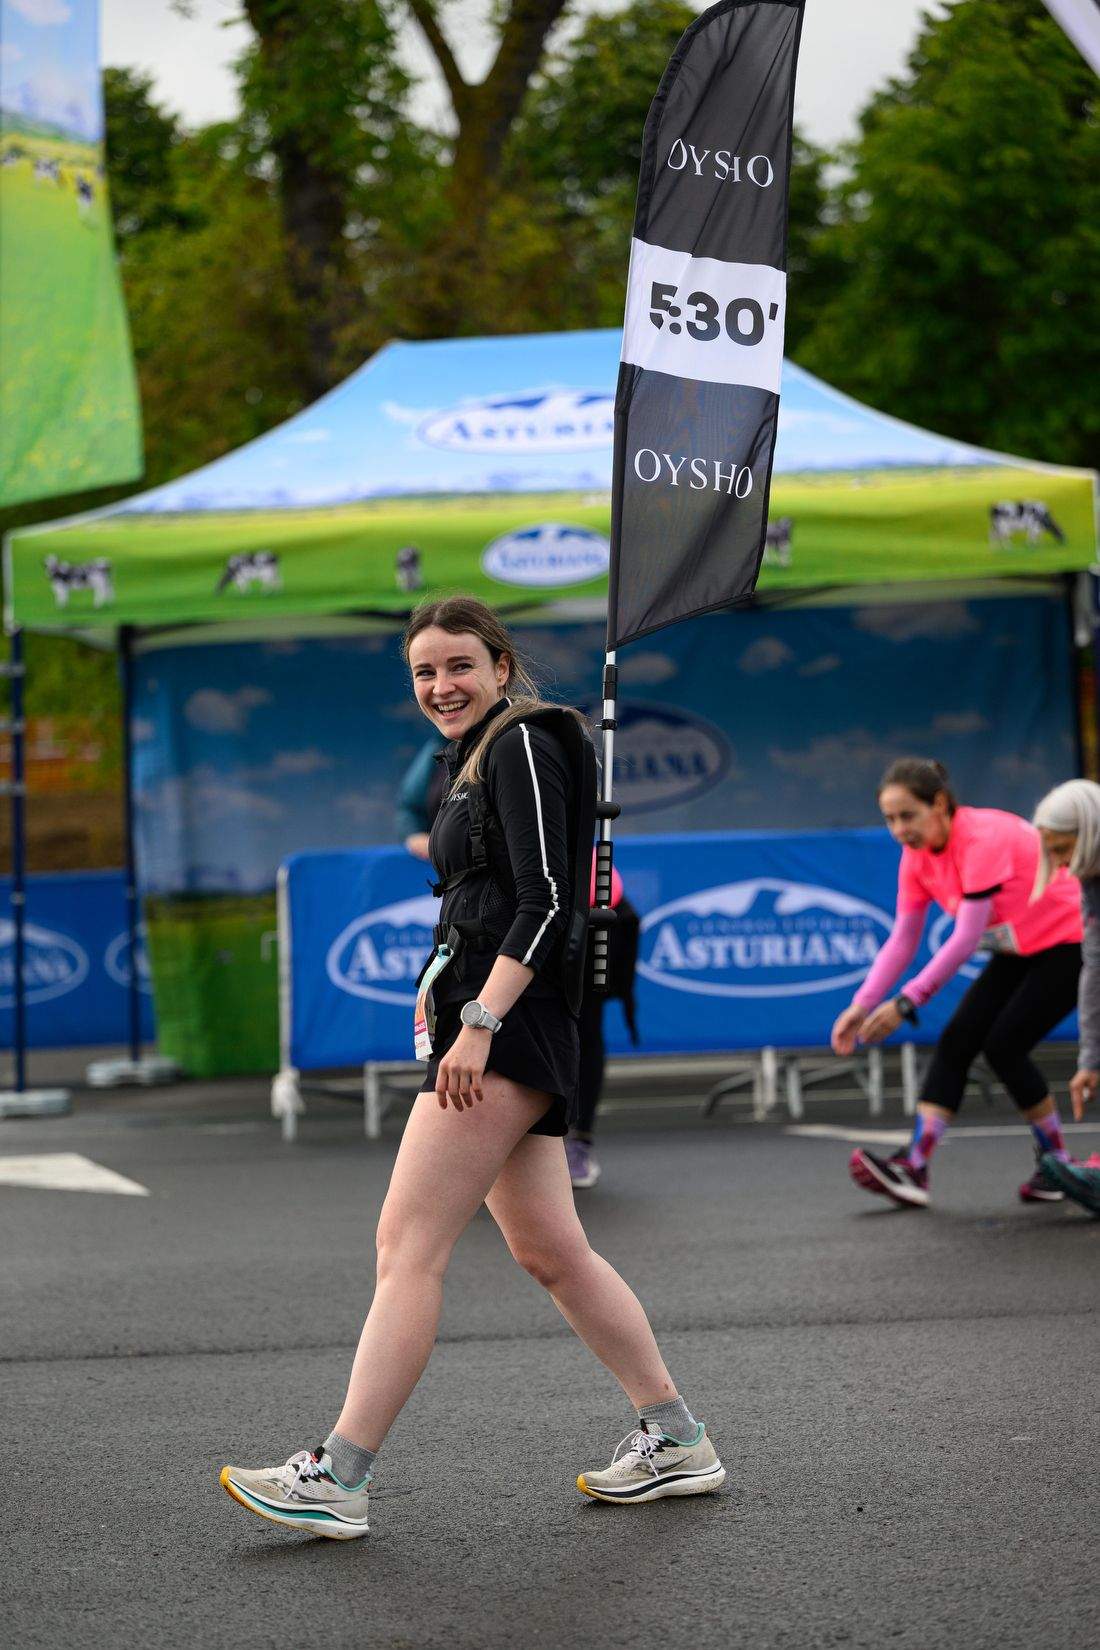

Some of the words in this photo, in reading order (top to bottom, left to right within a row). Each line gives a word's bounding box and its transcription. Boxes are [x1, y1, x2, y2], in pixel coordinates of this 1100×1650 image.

[667, 138, 774, 188] OYSHO
[634, 448, 754, 499] OYSHO
[651, 922, 881, 970] ASTURIANA
